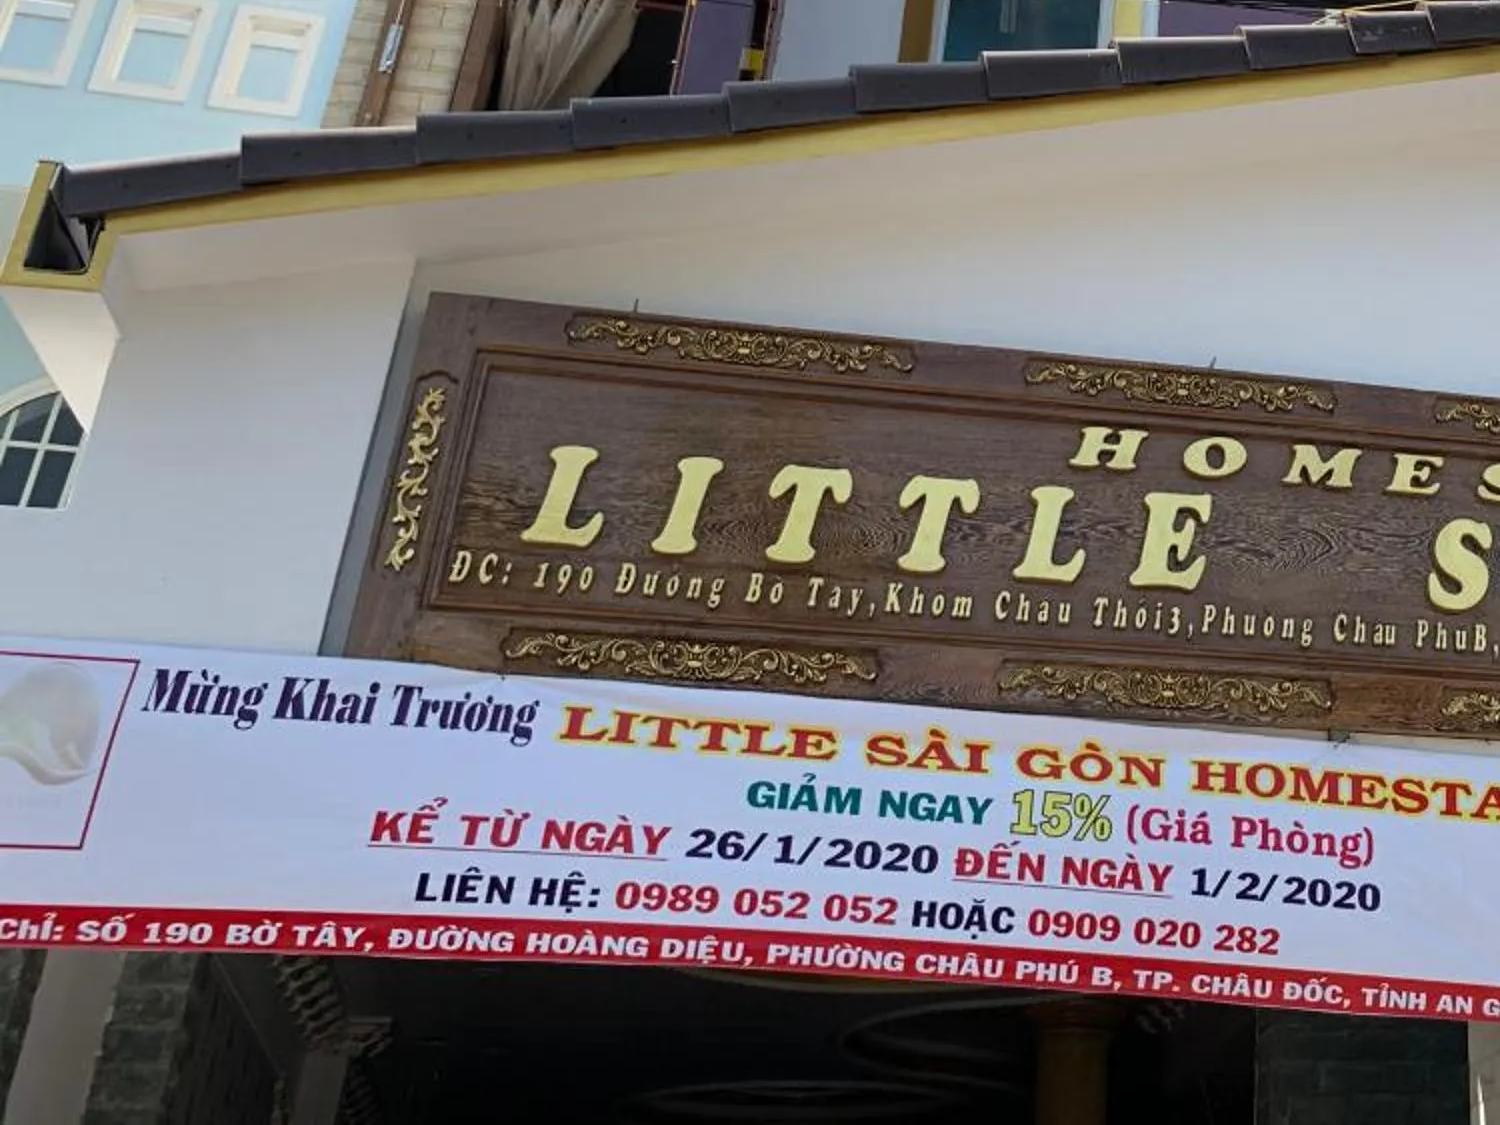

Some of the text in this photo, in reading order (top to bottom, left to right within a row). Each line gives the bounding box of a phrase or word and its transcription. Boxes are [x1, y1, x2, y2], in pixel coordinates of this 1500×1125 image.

[520, 445, 1213, 591] LITTLE
[533, 562, 594, 594] 190
[141, 668, 269, 731] Mừng
[273, 676, 381, 726] Khai
[390, 683, 541, 748] Trương
[558, 705, 838, 763] LITTLE
[865, 727, 992, 774] SÀI
[1016, 743, 1166, 789] GÒN
[369, 797, 1381, 912] KỂ TỪ NGÀY 26/1/2020 ĐẾN NGÀY 1/2/2020
[746, 773, 1375, 869] GIẢM NGAY 15% (Giá Phòng)
[416, 866, 1281, 956] LIÊN HỆ: 0989 052 052 HOẶC 0909 020 282
[75, 912, 136, 943] SỐ
[143, 922, 213, 944] 190
[225, 918, 282, 946] BỜ
[293, 921, 375, 952] TÂY,
[388, 922, 514, 954] ĐƯỜNG
[526, 930, 650, 959] HOÀNG
[660, 933, 754, 966] DIỆU,
[767, 938, 904, 973] PHƯỜNG
[915, 950, 1003, 980] CHÂU
[1015, 956, 1080, 985] PHÚ
[1091, 967, 1122, 991] B,
[1133, 968, 1180, 993] TP.
[1191, 970, 1273, 998] CHÂU
[1283, 974, 1351, 1007] ĐỐC,
[1361, 983, 1428, 1012] TỈNH
[1436, 993, 1474, 1016] AN
